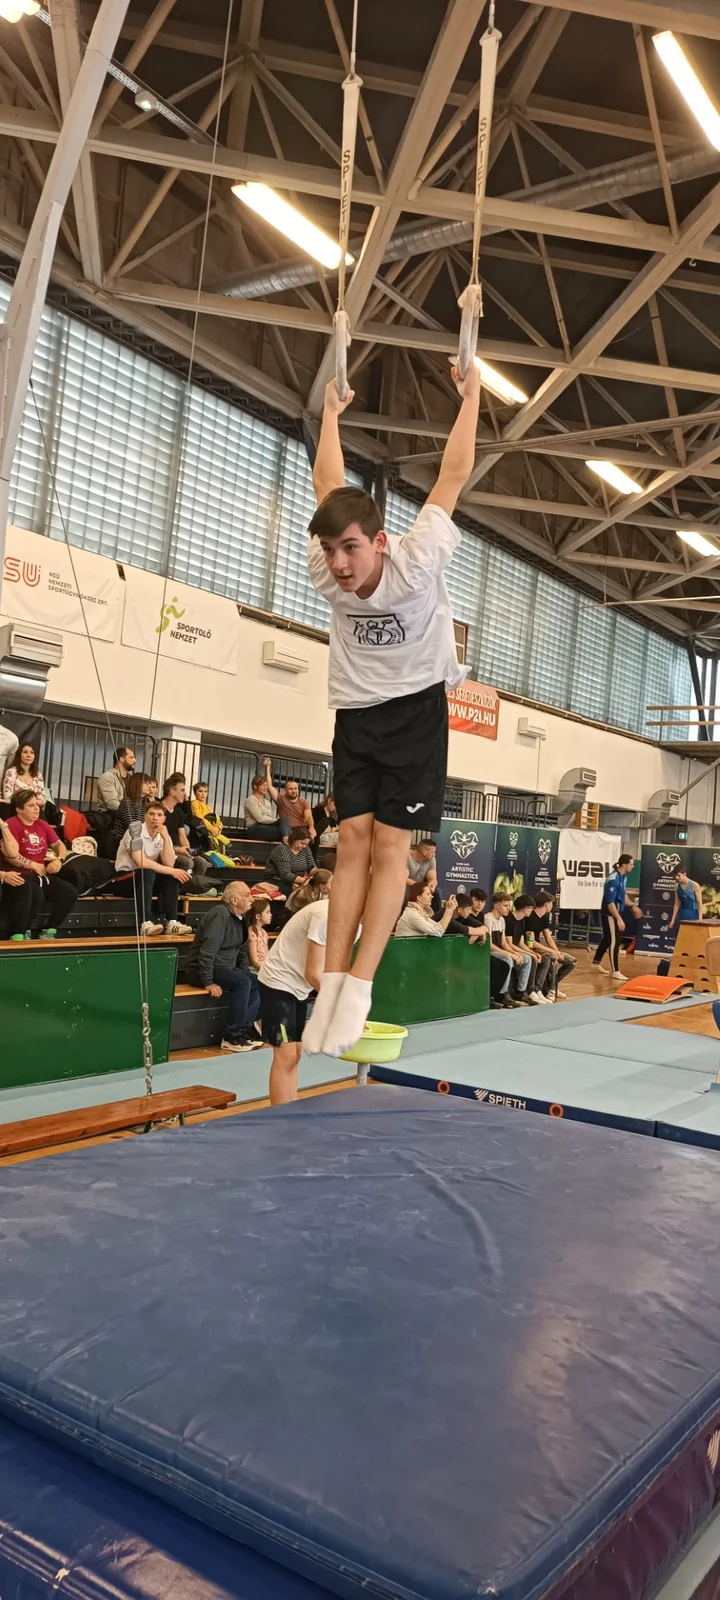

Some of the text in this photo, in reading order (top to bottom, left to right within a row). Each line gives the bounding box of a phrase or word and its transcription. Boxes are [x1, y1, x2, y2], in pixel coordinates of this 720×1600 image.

[475, 117, 487, 214] SPIETH
[340, 150, 351, 239] SPIETH
[48, 578, 72, 589] NEMZETI
[170, 630, 197, 644] NEMZET
[177, 622, 211, 639] SPORTOLÓ
[448, 701, 496, 727] WW.P2I.HU
[445, 872, 479, 880] GYMNASTICS
[488, 1093, 526, 1110] SPIETH
